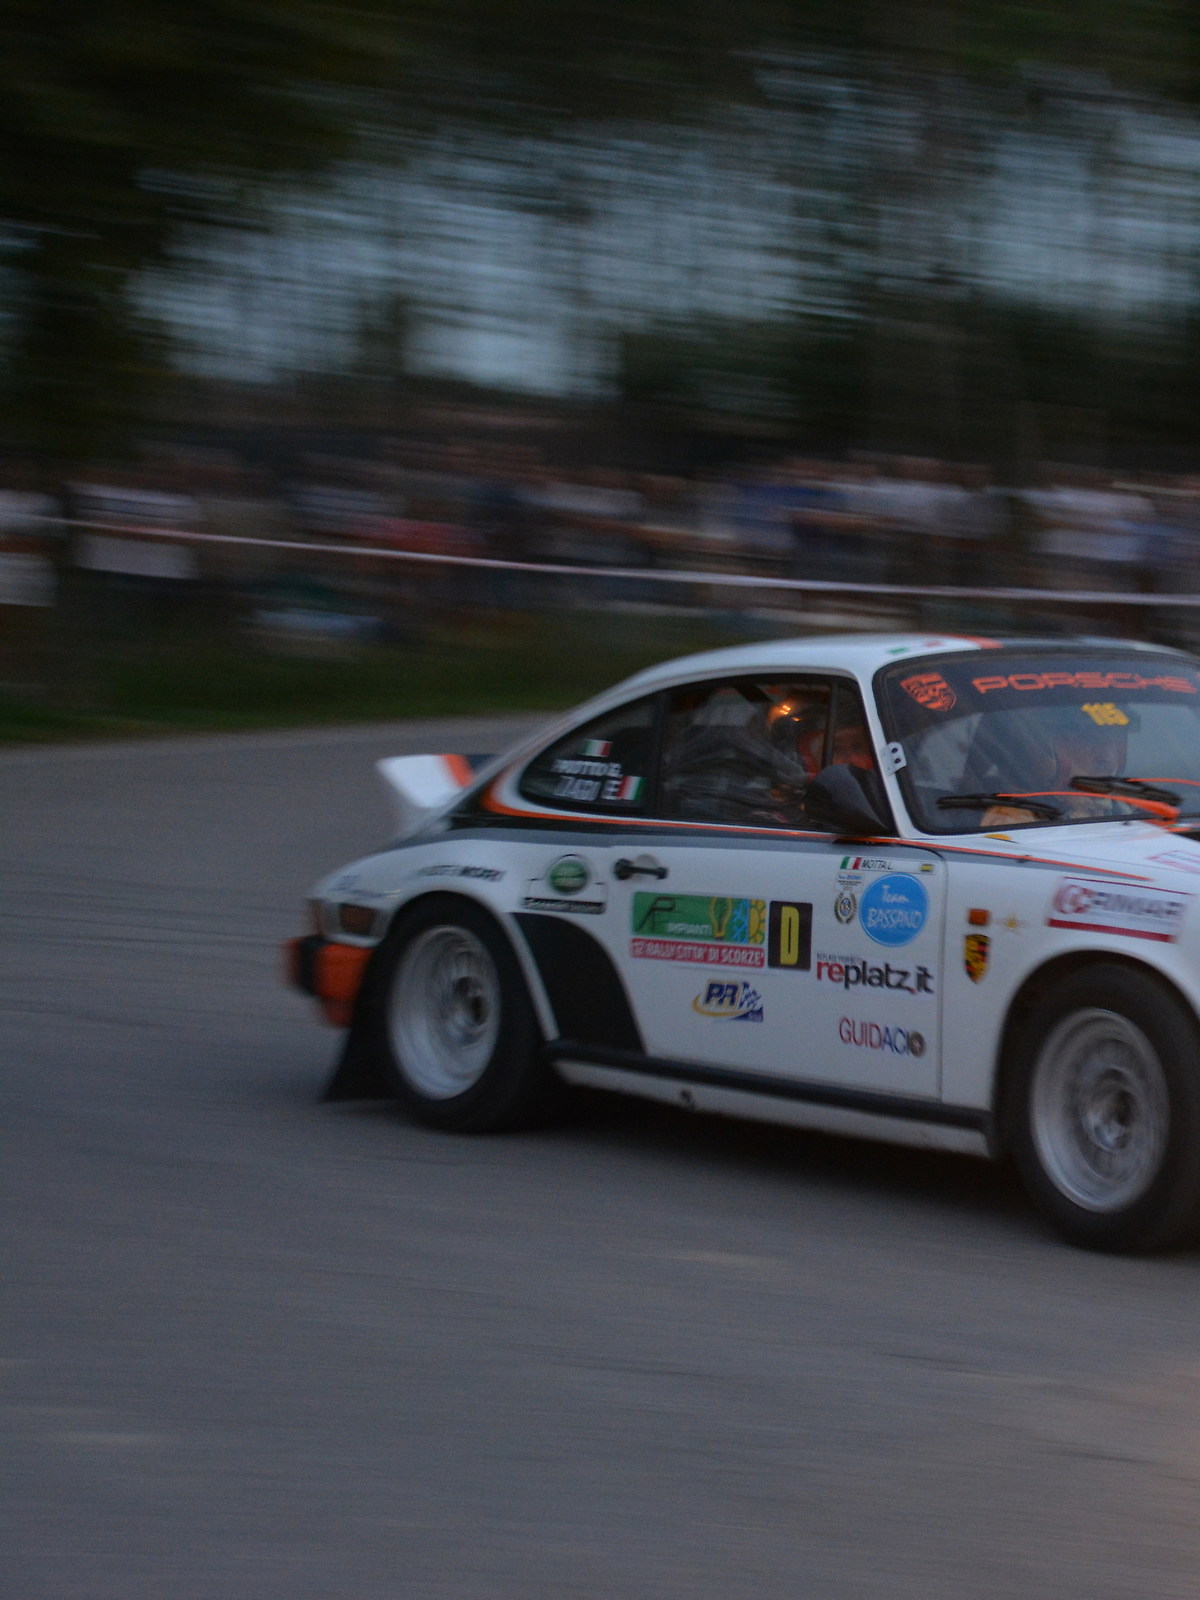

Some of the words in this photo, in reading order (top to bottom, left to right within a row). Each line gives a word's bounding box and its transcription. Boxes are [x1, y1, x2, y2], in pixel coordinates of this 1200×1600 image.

[972, 672, 1197, 694] PORSCHE
[861, 859, 886, 869] MOTTA
[867, 908, 923, 929] BASSANO
[779, 905, 800, 966] D
[708, 946, 719, 961] DI
